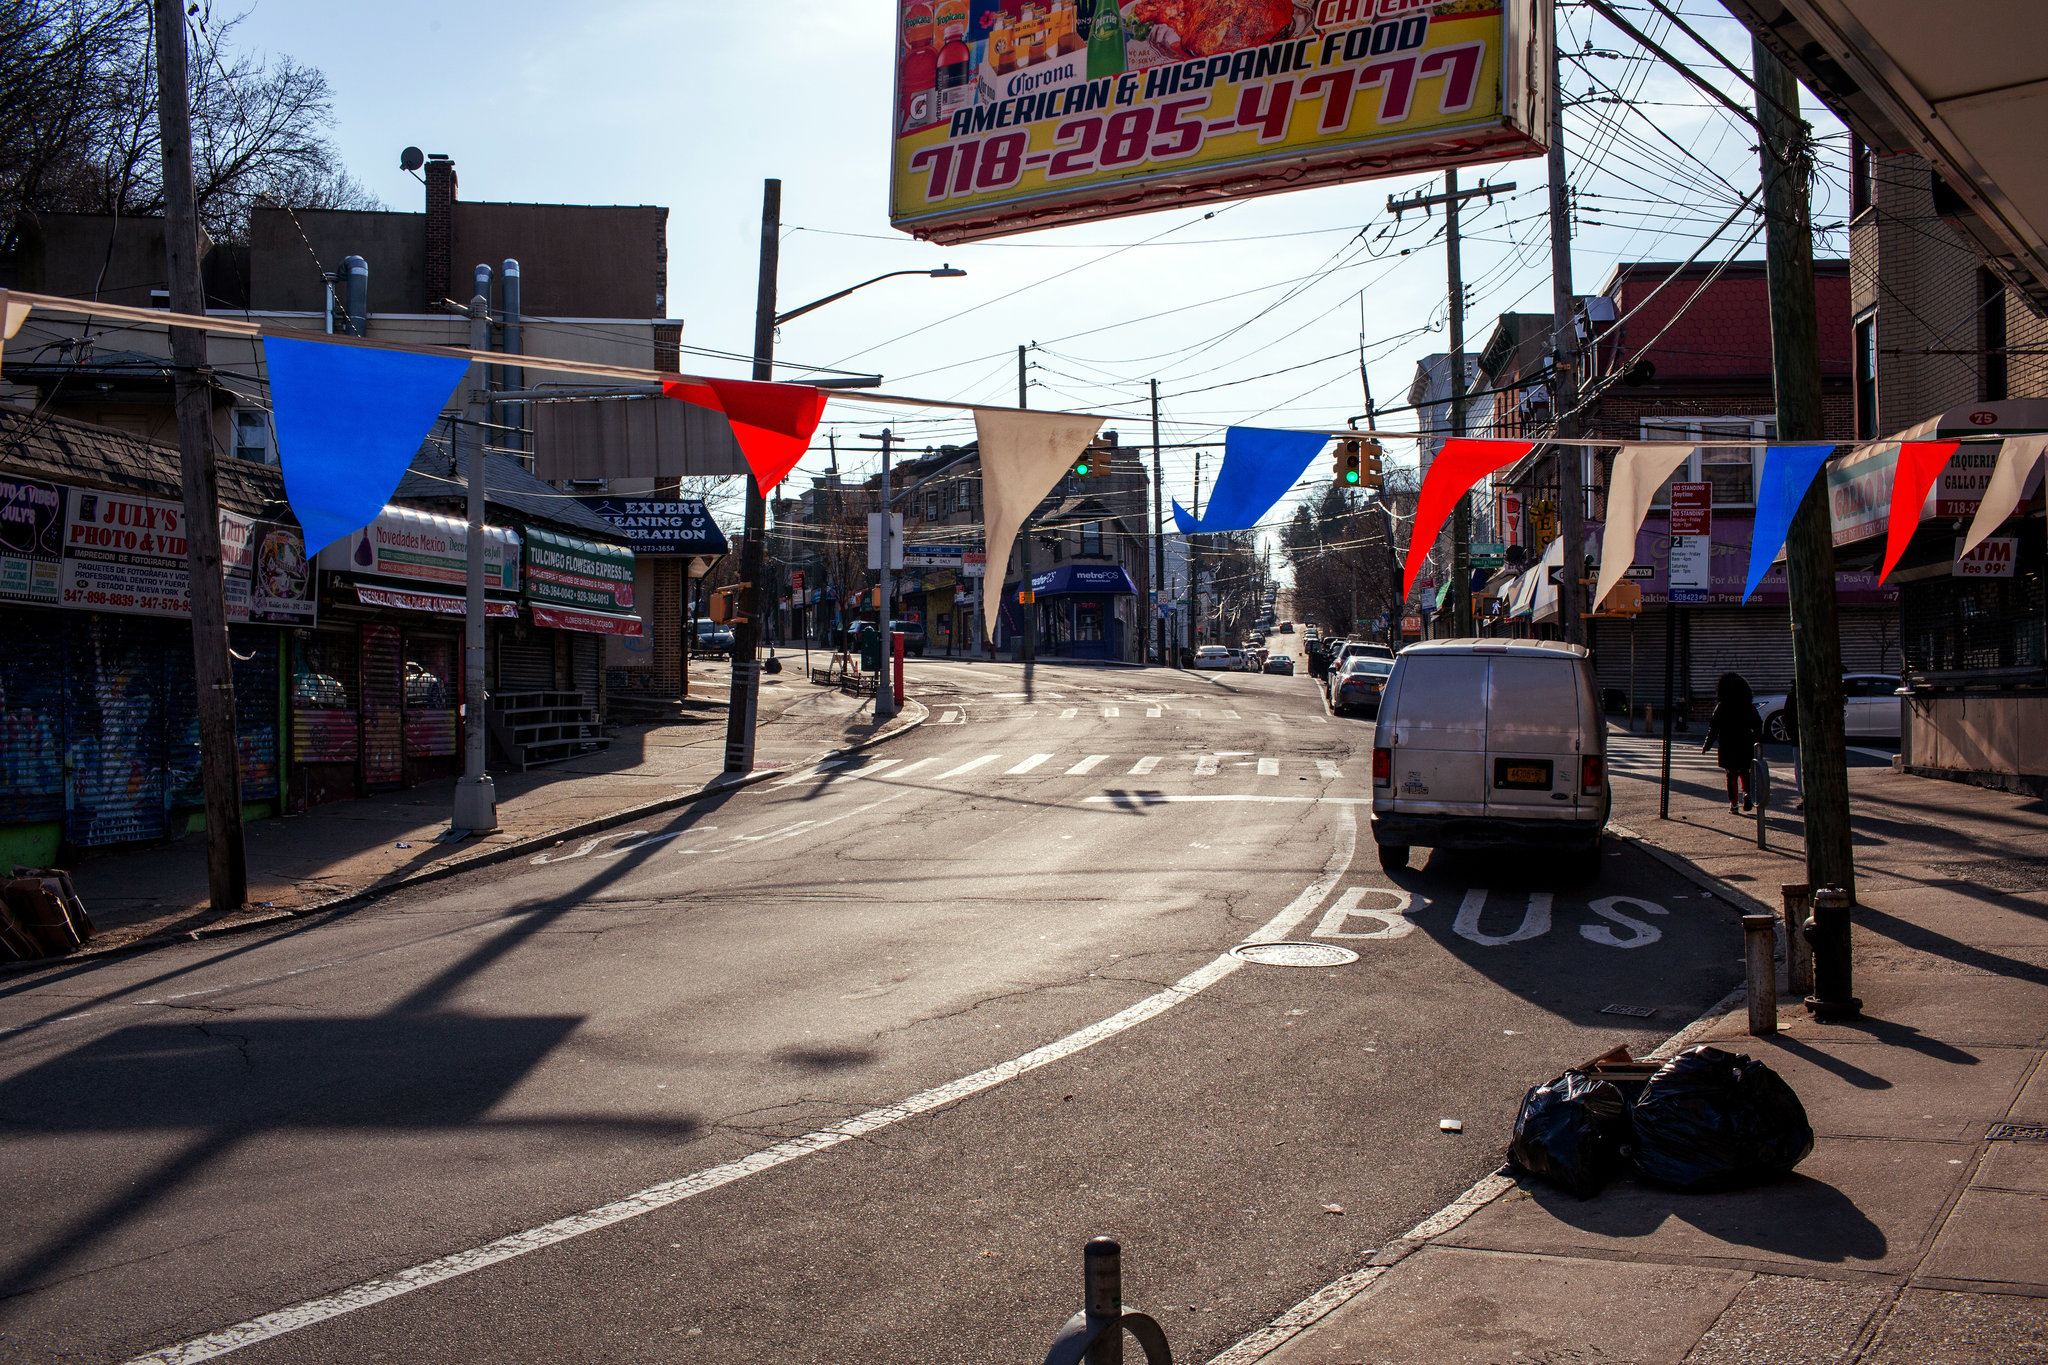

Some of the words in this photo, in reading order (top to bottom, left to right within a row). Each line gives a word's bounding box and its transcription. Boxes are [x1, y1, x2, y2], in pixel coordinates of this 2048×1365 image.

[905, 15, 931, 29] Tropicana
[937, 12, 967, 26] Tropicana
[949, 79, 1111, 137] AMERICAN
[1116, 73, 1139, 105] &
[1145, 38, 1317, 99] HISPANIC
[1321, 16, 1429, 66] FOOD
[1007, 64, 1073, 97] Corona
[911, 44, 1482, 199] 718-285-4777
[1974, 413, 1994, 423] 75
[1950, 455, 1997, 471] TAQUERIA
[1945, 475, 1976, 489] GALLO
[18, 487, 27, 501] &
[29, 488, 57, 507] VIDEO
[1835, 478, 1873, 519] GALLO
[2, 506, 36, 525] JULY'S
[103, 501, 177, 531] JULY'S
[625, 502, 703, 515] EXPERT
[691, 517, 705, 527] &
[70, 524, 137, 550] PHOTO
[139, 533, 154, 551] &
[156, 535, 188, 555] VID
[376, 526, 419, 549] Novedades
[420, 535, 446, 553] Mexico
[1673, 536, 1680, 547] 2
[119, 554, 128, 562] DE
[131, 556, 176, 569] FOTOGRAFIAS
[530, 546, 565, 568] TULCINGO
[565, 556, 595, 576] FLOWERS
[595, 561, 622, 580] EXPRESS
[622, 567, 634, 582] Inc.
[1962, 563, 1981, 573] Fee
[1984, 562, 2006, 574] 99¢
[75, 570, 128, 583] PROFESSIONAL
[130, 575, 157, 585] DENTRO
[164, 580, 186, 588] FUERA
[78, 562, 115, 573] PAQUETES
[127, 567, 168, 579] FOTOGRAFIA
[176, 572, 190, 580] VIDE
[1077, 571, 1119, 580] metroPCS
[1710, 575, 1725, 584] For
[1727, 575, 1739, 584] All
[1843, 574, 1871, 584] Pastry
[97, 581, 124, 591] ESTADO
[136, 586, 159, 594] NUEVA
[160, 588, 179, 596] YORK
[64, 589, 134, 606] 347-898-8839
[1718, 593, 1763, 602] Premses
[1310, 886, 1670, 949] BUS
